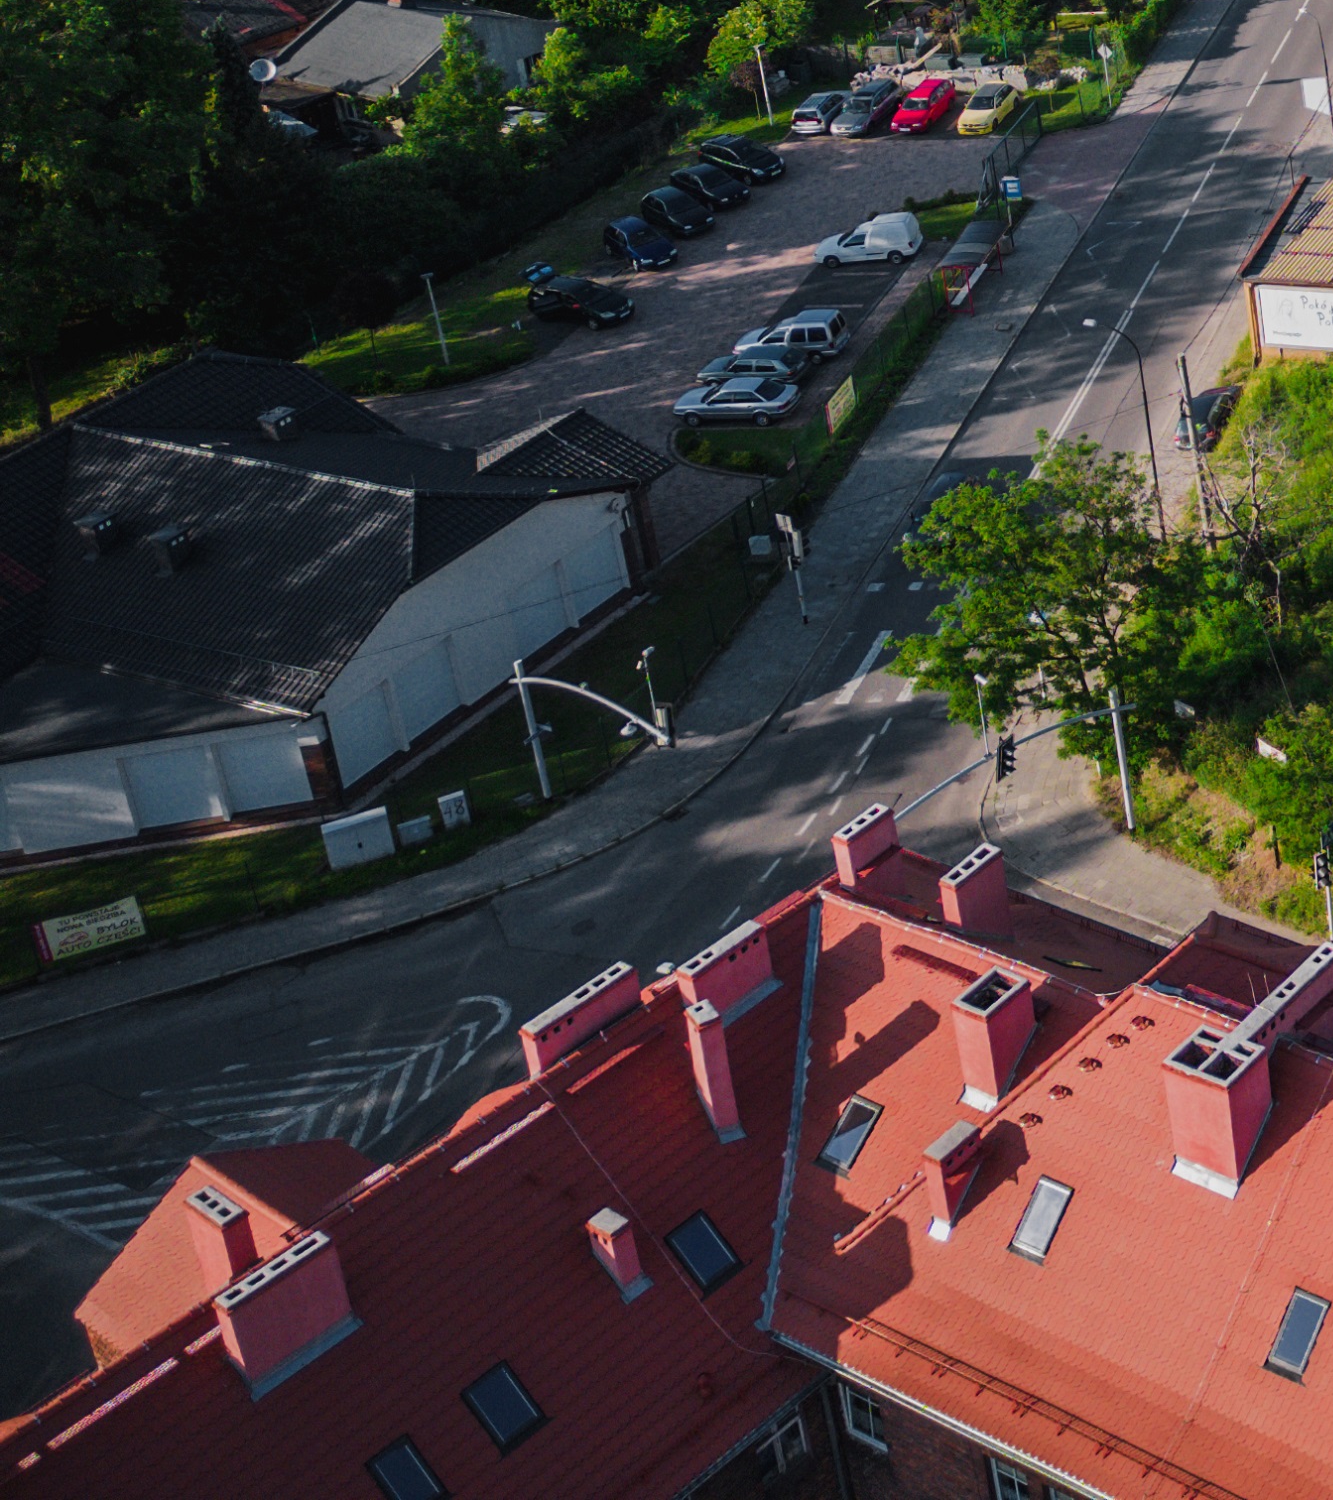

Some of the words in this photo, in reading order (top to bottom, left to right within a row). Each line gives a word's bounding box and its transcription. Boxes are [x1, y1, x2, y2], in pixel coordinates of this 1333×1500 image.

[444, 799, 465, 818] 48
[56, 922, 84, 933] NOWA
[85, 910, 126, 925] SIEDZIBA
[58, 918, 71, 926] TU
[72, 904, 120, 919] POWSTAJE
[96, 916, 139, 934] BYLOK
[57, 940, 92, 956] AUTO
[97, 926, 141, 944] CZĘŚCI
